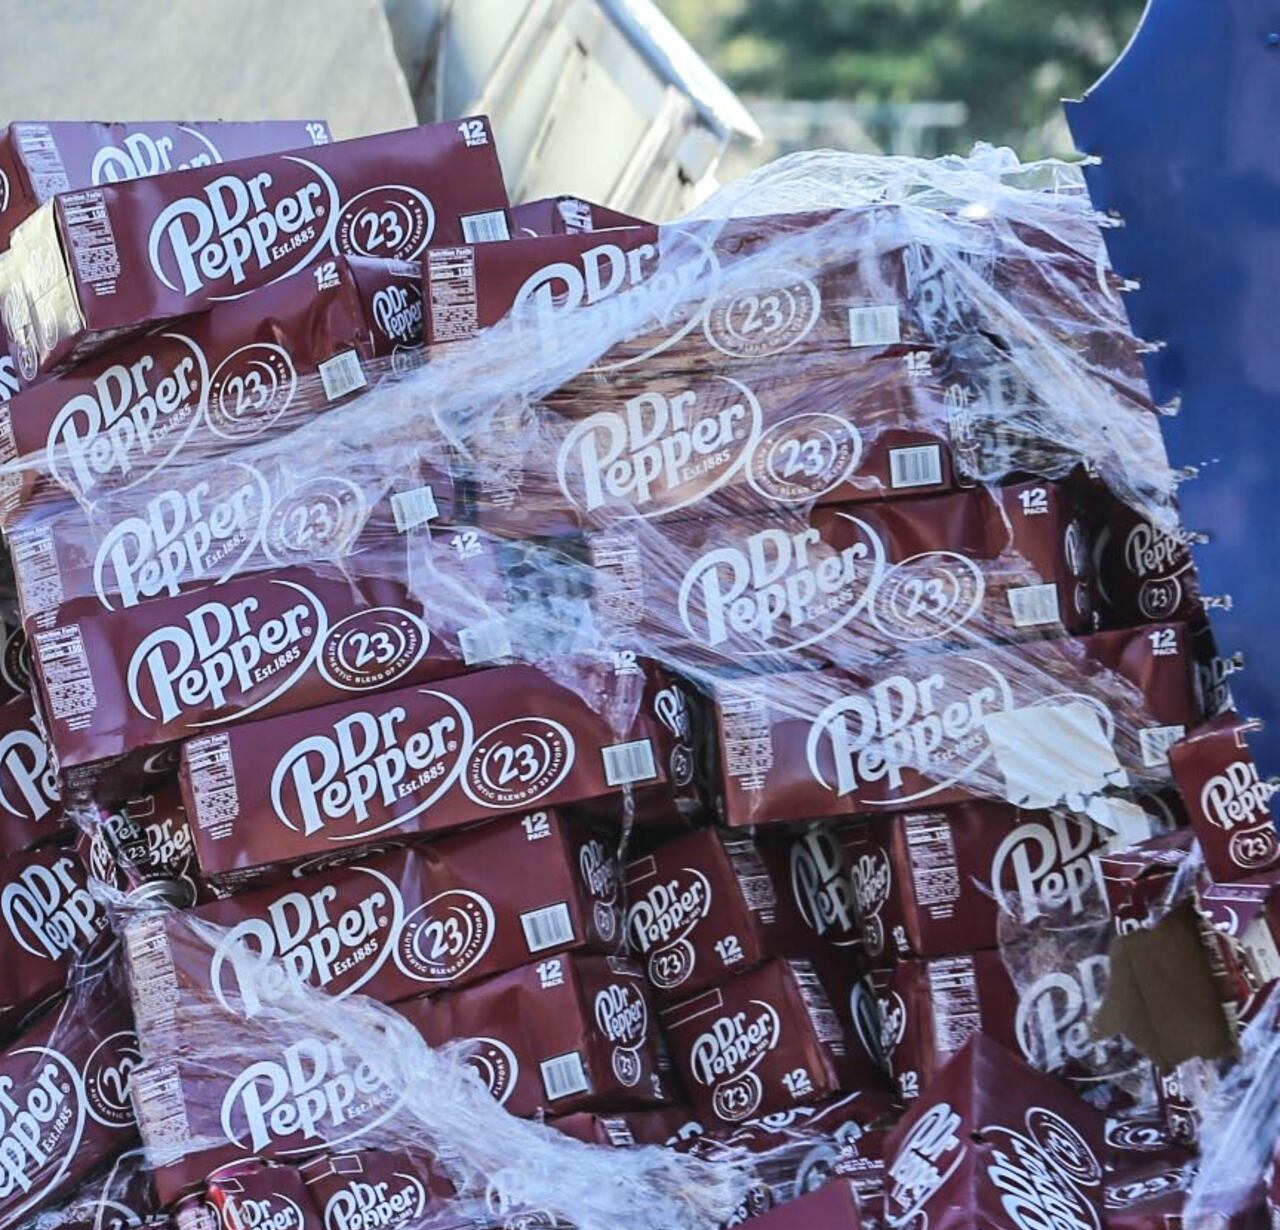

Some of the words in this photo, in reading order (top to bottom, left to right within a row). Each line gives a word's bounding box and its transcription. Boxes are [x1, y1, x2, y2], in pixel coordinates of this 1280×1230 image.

[306, 123, 326, 141] 12
[458, 119, 487, 139] 12
[204, 170, 274, 228] Dr
[150, 188, 321, 297] Pepper
[272, 227, 316, 262] Est.1885
[357, 210, 404, 248] 23
[315, 266, 339, 283] 12
[739, 295, 783, 333] 23
[904, 351, 931, 371] 12
[907, 365, 933, 377] PACK
[97, 353, 156, 408] Dr
[641, 390, 697, 441] Dr
[559, 402, 744, 511] Pepper
[150, 476, 210, 537] Dr
[1019, 488, 1046, 507] 12
[751, 526, 821, 589] Dr
[903, 577, 944, 613] 23
[184, 595, 260, 653] Dr
[1150, 628, 1177, 650] 12
[129, 609, 310, 724] Pepper
[254, 646, 302, 684] Est.1885
[328, 640, 352, 681] AUTHENTIC
[355, 674, 383, 683] BLEND
[404, 628, 417, 658] FLAVORS
[1153, 643, 1177, 656] PACK
[875, 676, 944, 736] Dr
[336, 703, 407, 765] Dr
[272, 719, 455, 837] Pepper
[397, 762, 446, 798] Est.1885
[472, 756, 495, 799] AUTHENTIC
[497, 792, 526, 801] BLEND
[547, 740, 562, 777] FLAVORS
[1238, 836, 1270, 859] 23
[26, 858, 76, 903] Dr
[273, 882, 336, 942] Dr
[404, 931, 427, 972] AUTHENTIC
[430, 965, 456, 974] BLEND
[471, 911, 483, 948] FLAVORS
[425, 916, 466, 954] 23
[333, 939, 378, 976] Est.1885
[692, 1009, 772, 1087] Pepper
[710, 1013, 748, 1050] Dr
[899, 1072, 920, 1092] 12
